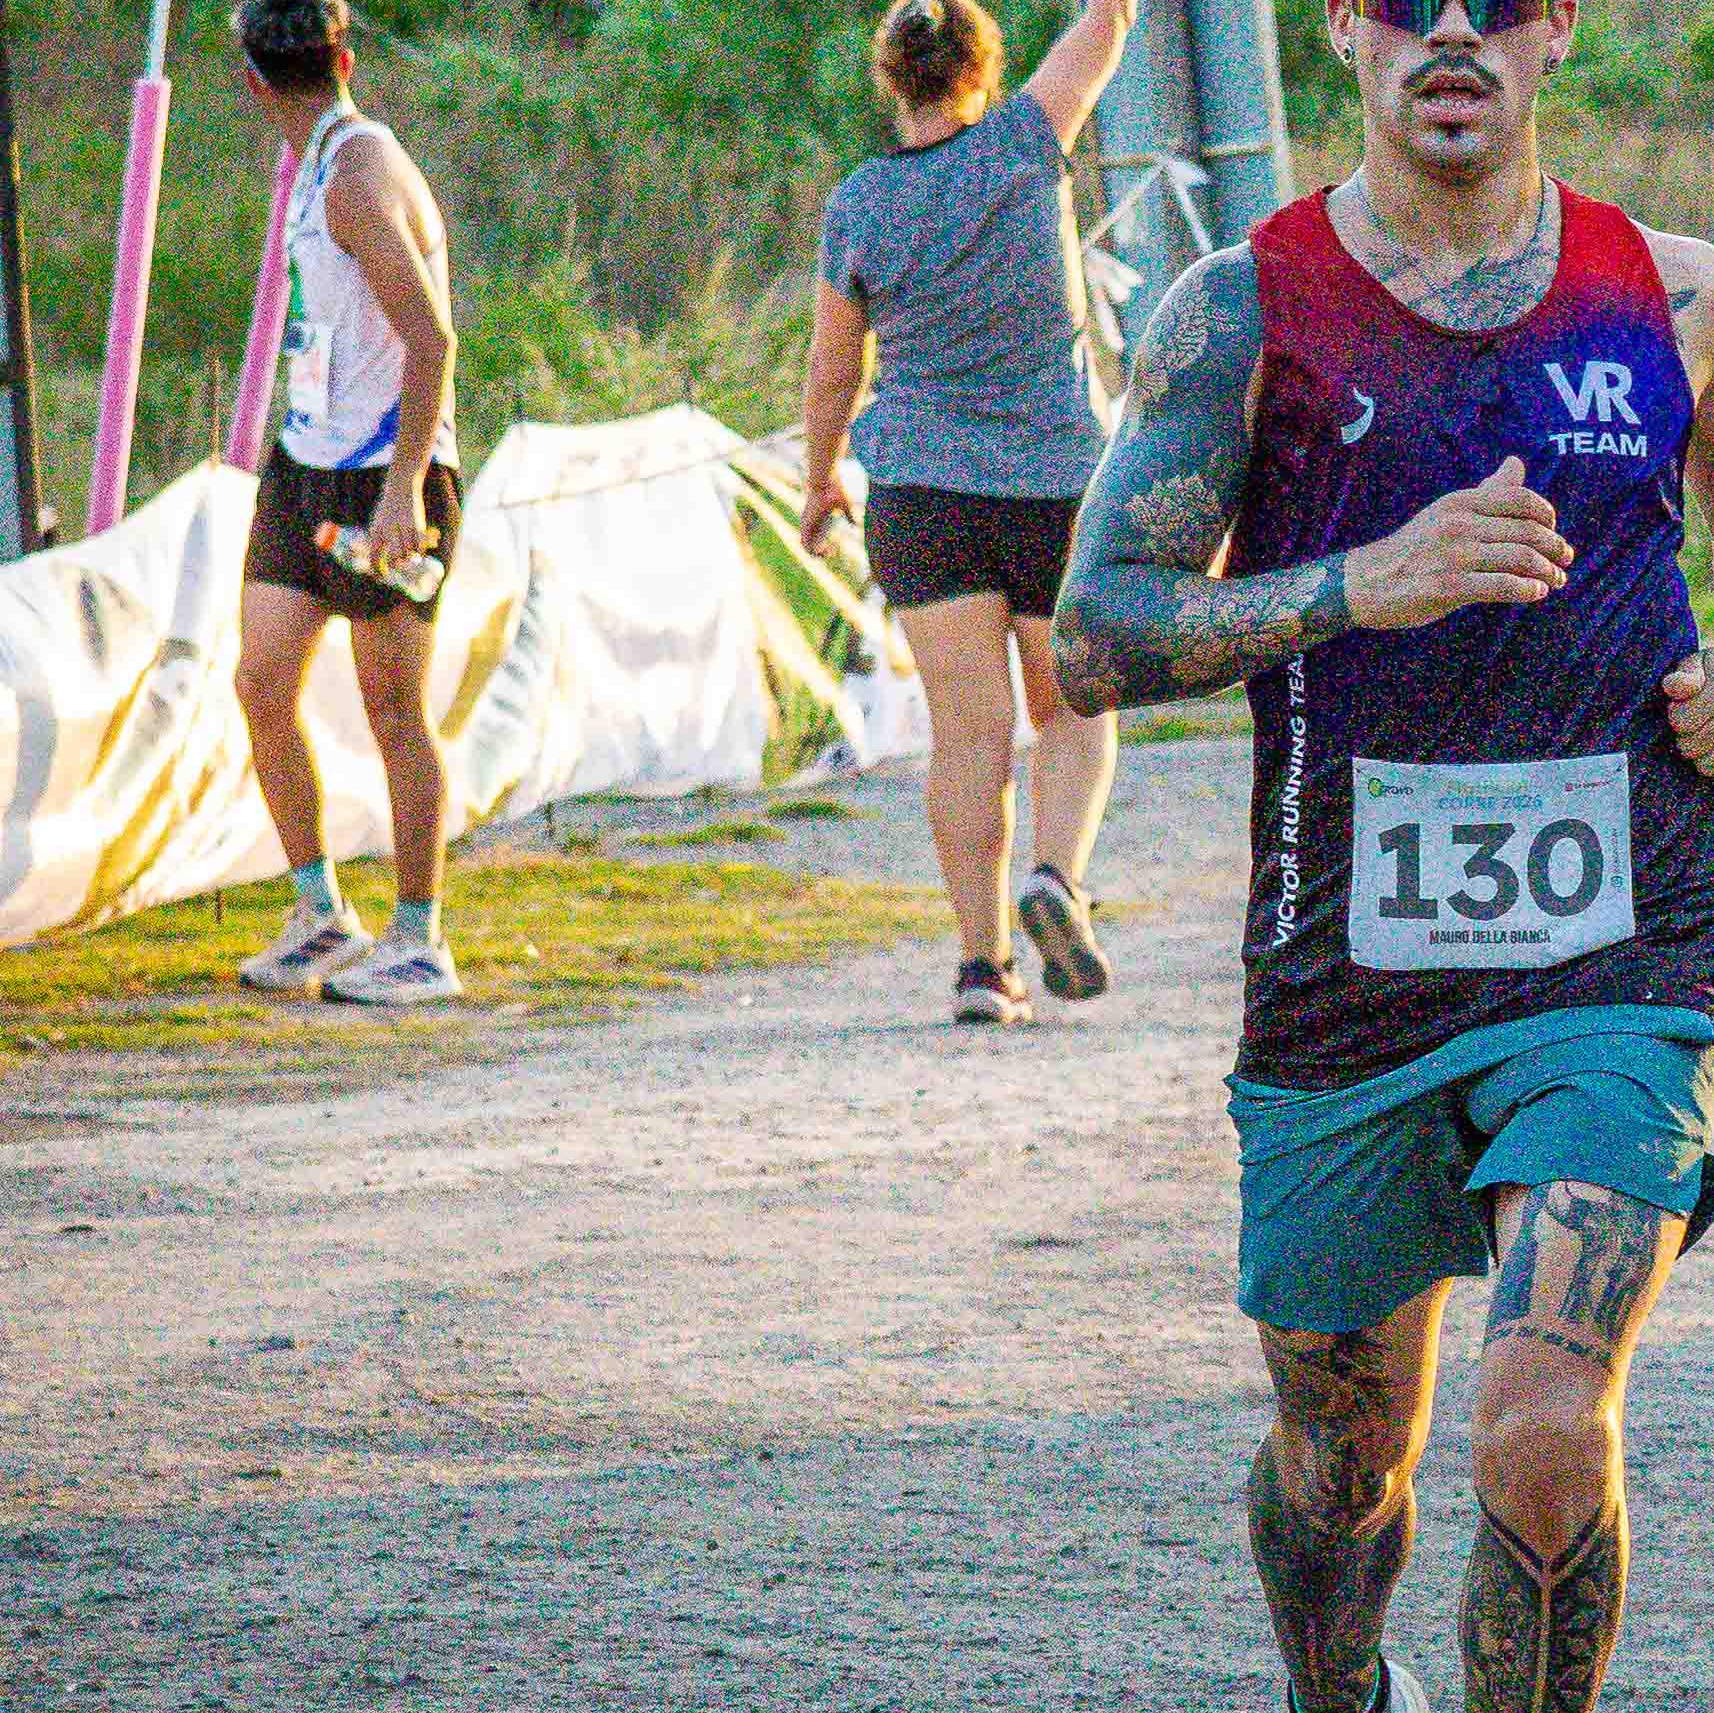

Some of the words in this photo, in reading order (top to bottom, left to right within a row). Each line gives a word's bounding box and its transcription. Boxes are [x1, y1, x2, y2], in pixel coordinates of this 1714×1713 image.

[1543, 360, 1641, 424] VR
[1548, 431, 1648, 458] TEAM
[1288, 653, 1306, 707] TEA
[1281, 716, 1307, 844] RUNNING
[1272, 853, 1300, 947] VICTOR
[1379, 818, 1603, 921] 130
[1429, 929, 1469, 944] MAURO
[1472, 929, 1507, 944] DELLA
[1510, 928, 1551, 944] BIANCA
